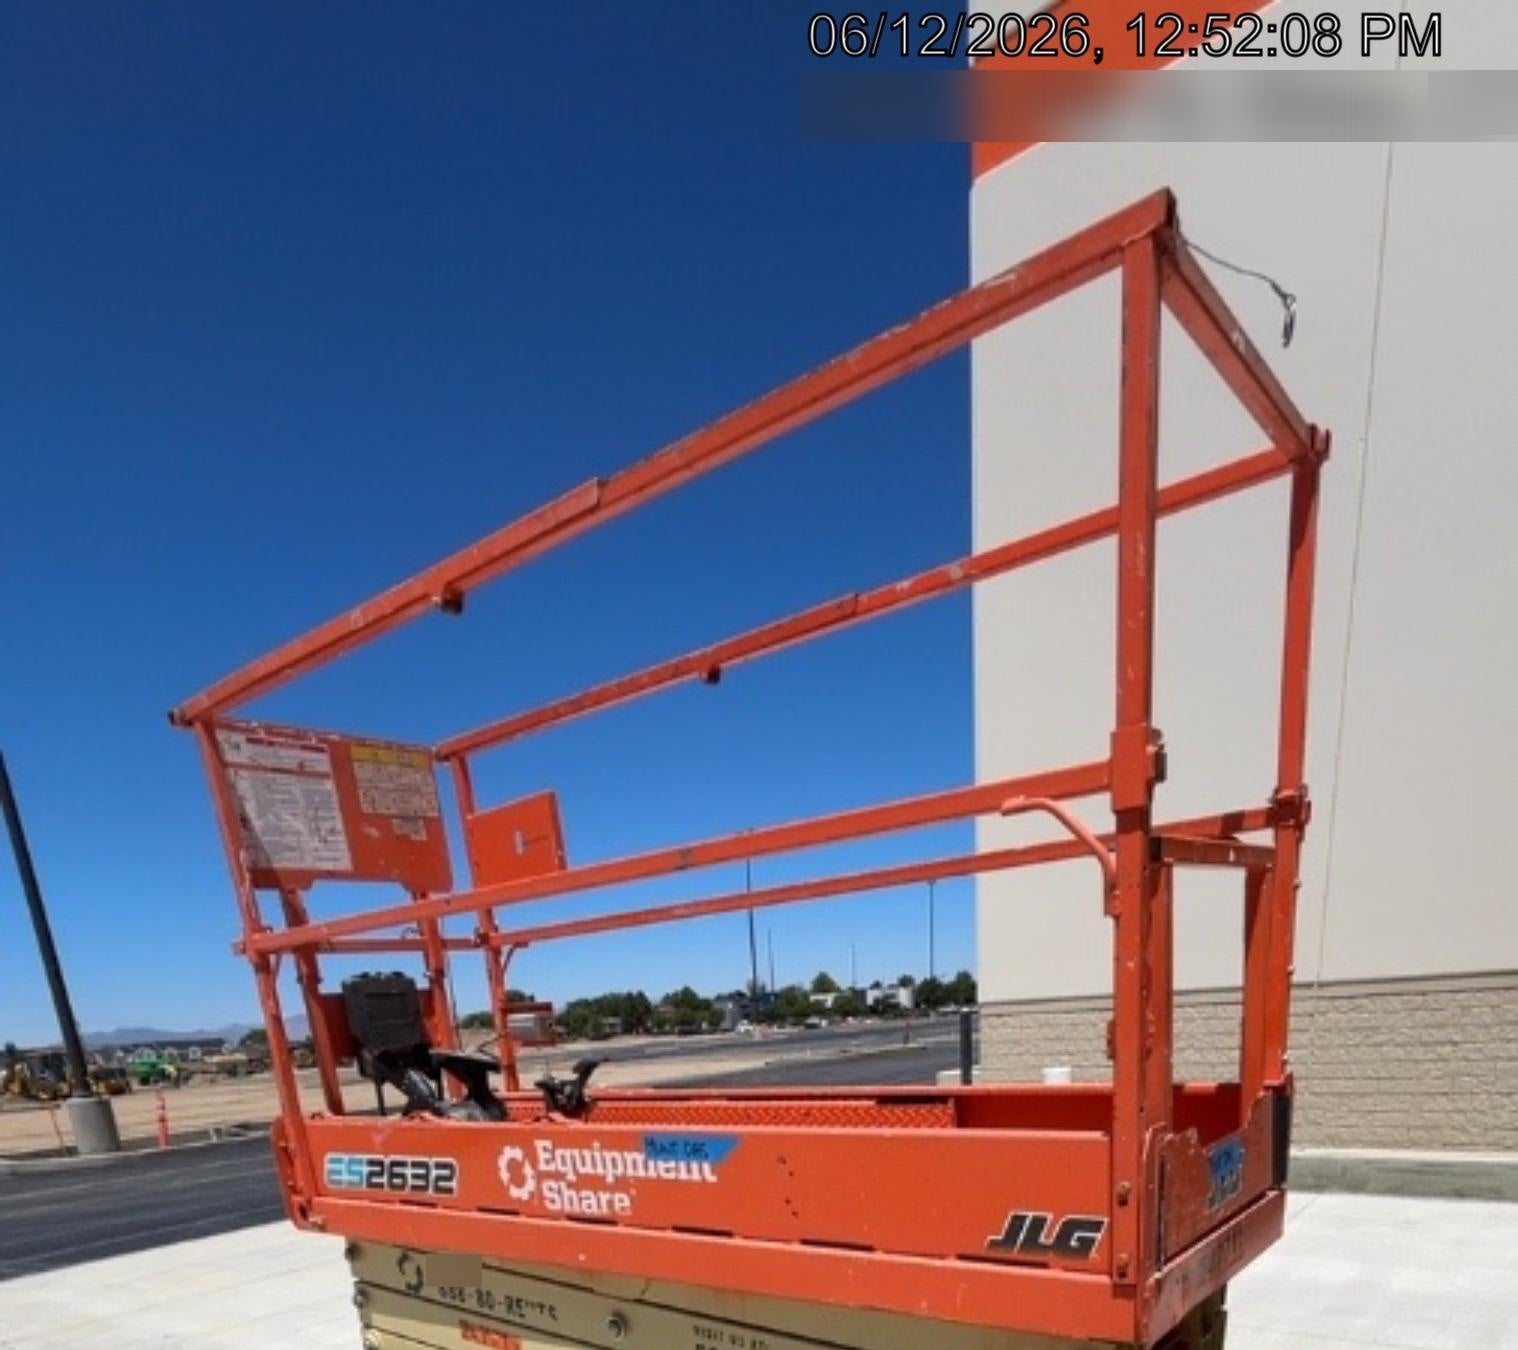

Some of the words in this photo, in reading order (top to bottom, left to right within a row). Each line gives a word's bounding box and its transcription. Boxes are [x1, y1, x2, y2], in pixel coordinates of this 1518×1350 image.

[326, 1154, 458, 1196] ES2632
[534, 1138, 718, 1183] Equipment
[542, 1180, 632, 1217] Share
[985, 1211, 1109, 1260] JLG
